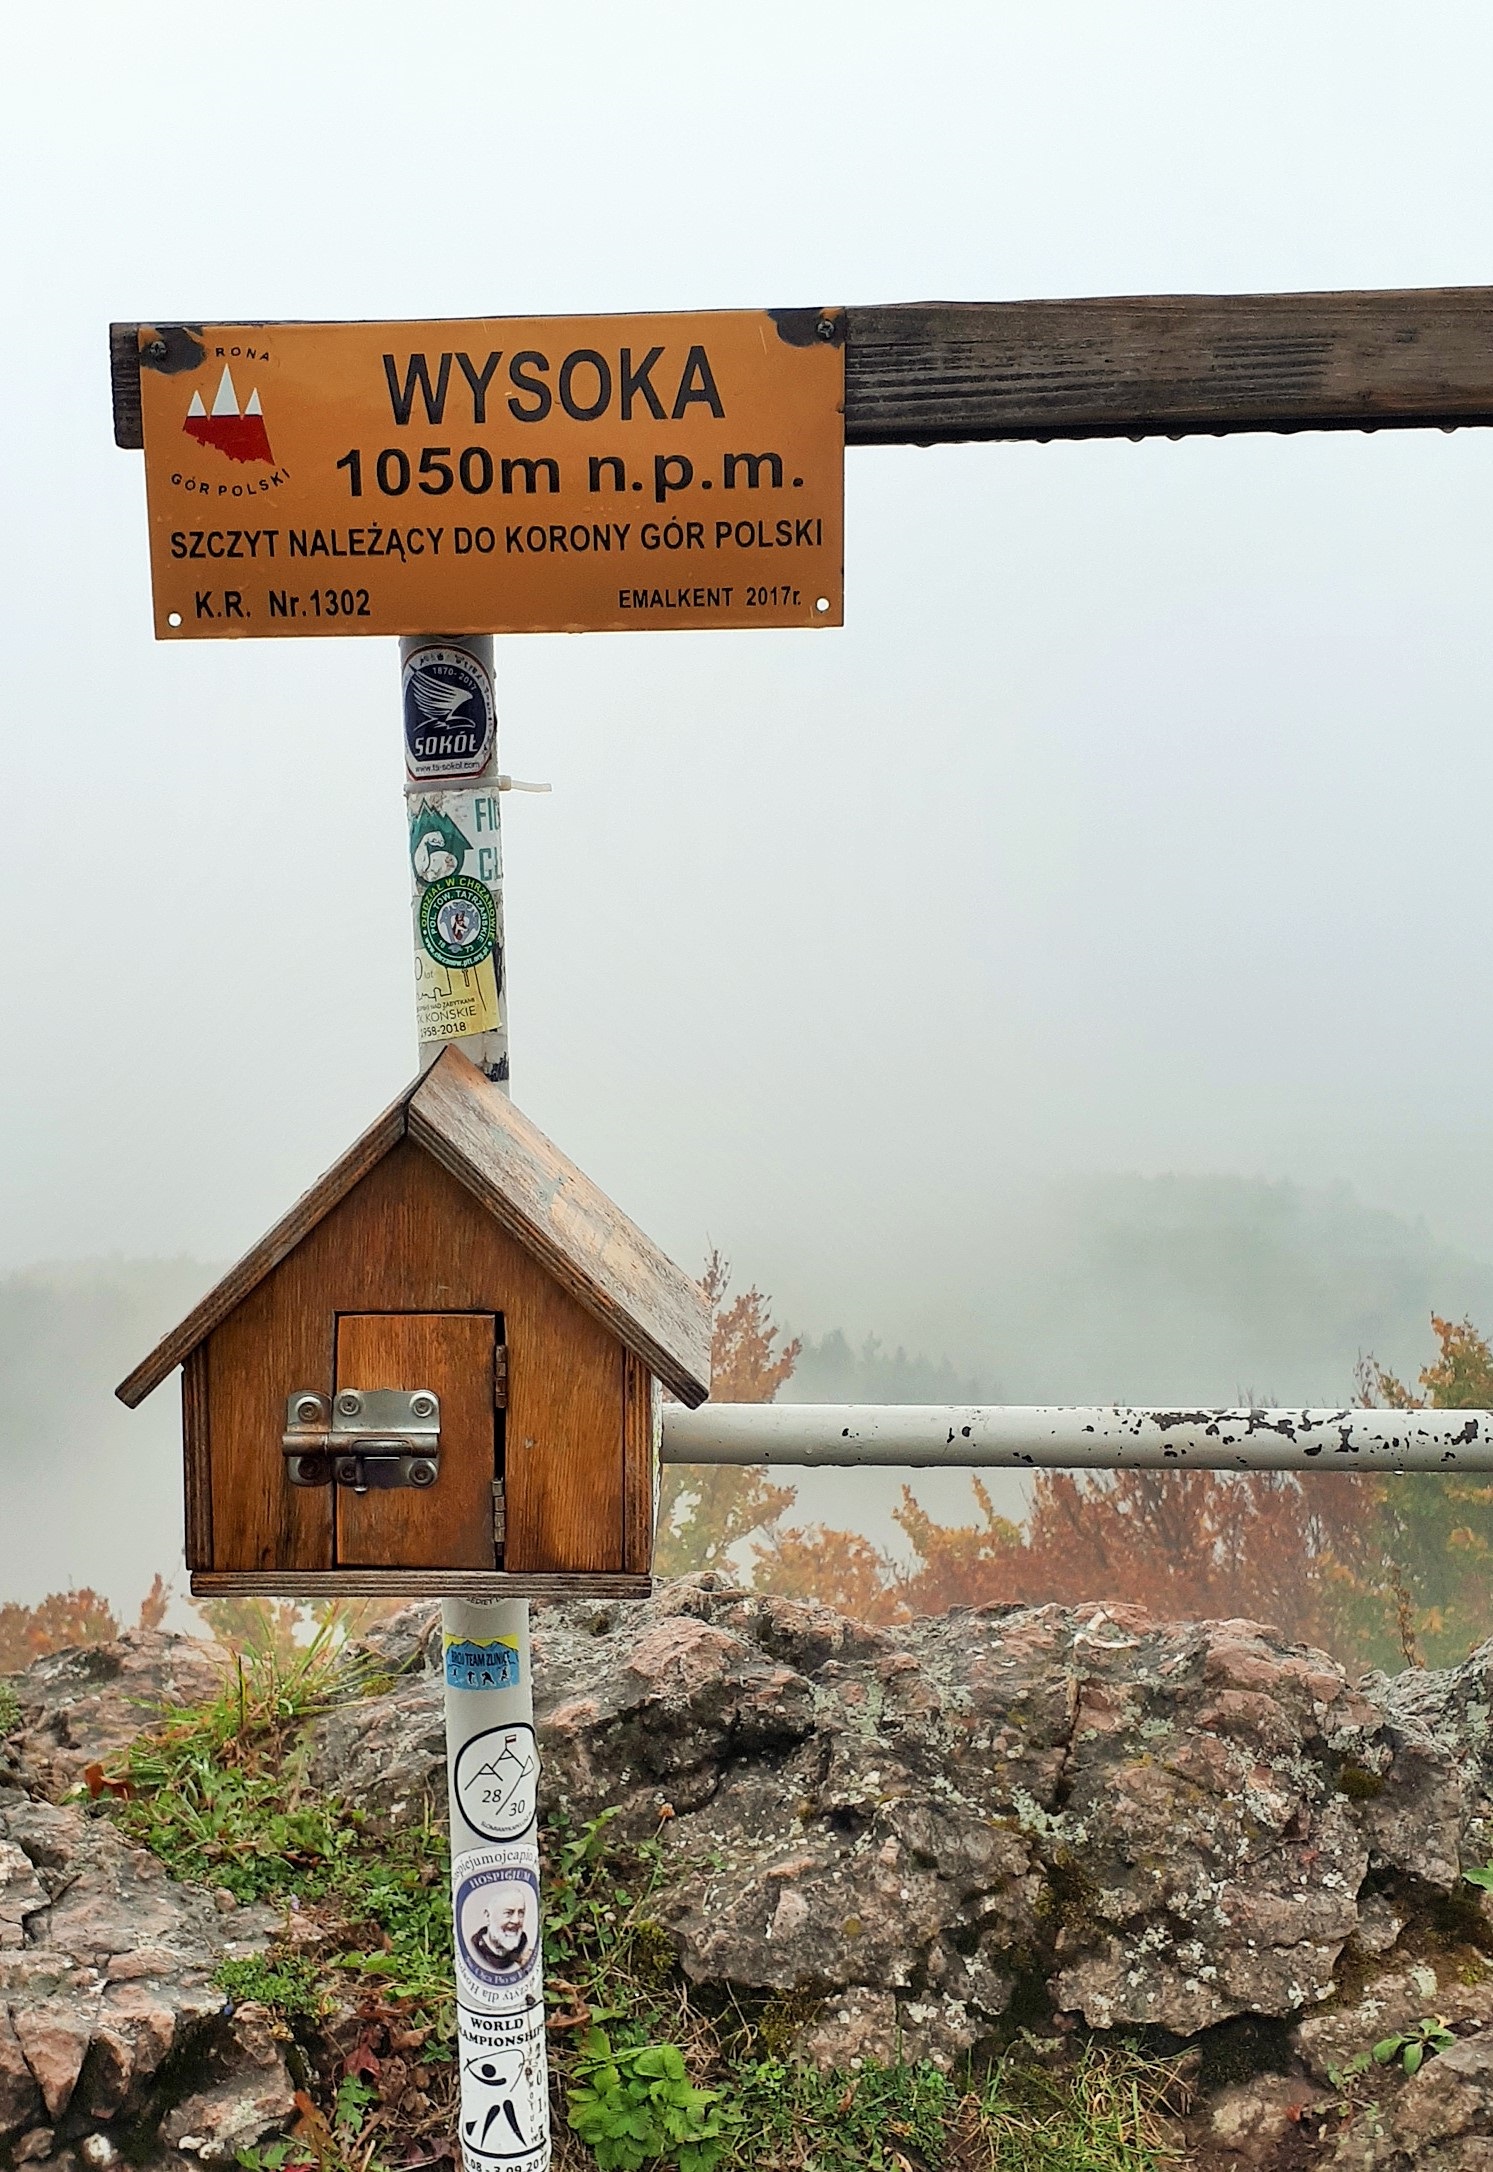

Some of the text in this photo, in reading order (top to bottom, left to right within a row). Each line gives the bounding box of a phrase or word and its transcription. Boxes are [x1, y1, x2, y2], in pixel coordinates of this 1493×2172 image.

[382, 345, 726, 426] WYSOKA
[171, 468, 291, 497] GÓR POLSKI
[336, 446, 805, 503] 1050m n.p.m.
[170, 515, 823, 563] SZCZYT NALEŻĄCY DO KORONY GÓR POLSKI
[195, 590, 251, 618] K.R.
[618, 585, 801, 608] EMALKENT 2017r.
[414, 731, 479, 757] SOKÓŁ
[445, 877, 456, 887] W
[459, 877, 497, 939] CHRZANOWIE
[481, 1788, 502, 1803] 28
[508, 1799, 526, 1817] 30
[470, 2016, 524, 2032] WORLD
